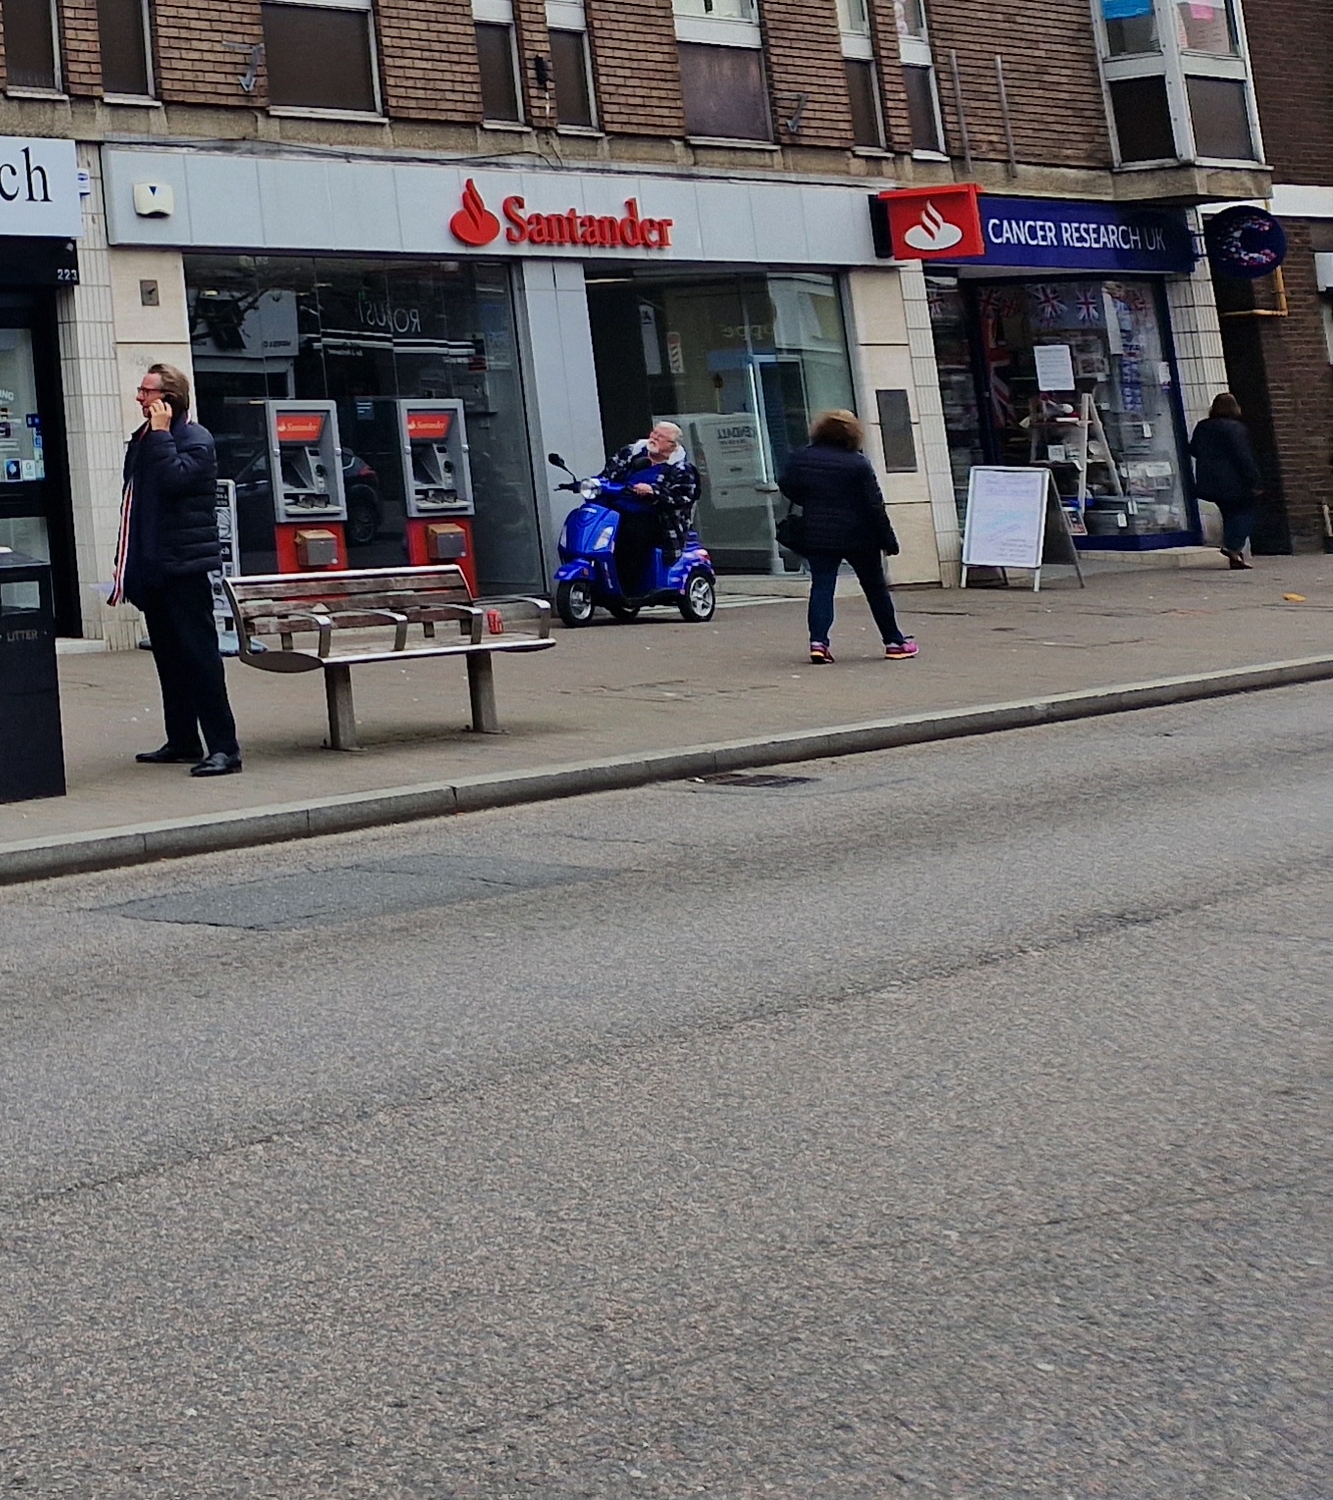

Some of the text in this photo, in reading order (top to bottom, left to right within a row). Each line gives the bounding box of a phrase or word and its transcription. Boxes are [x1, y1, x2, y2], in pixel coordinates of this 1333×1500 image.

[504, 196, 673, 249] Santander
[987, 217, 1167, 252] CANCER RESEARCH UK
[56, 268, 78, 281] 223
[285, 424, 318, 432] Santander
[414, 423, 446, 431] Santander
[6, 629, 39, 643] LITTER
